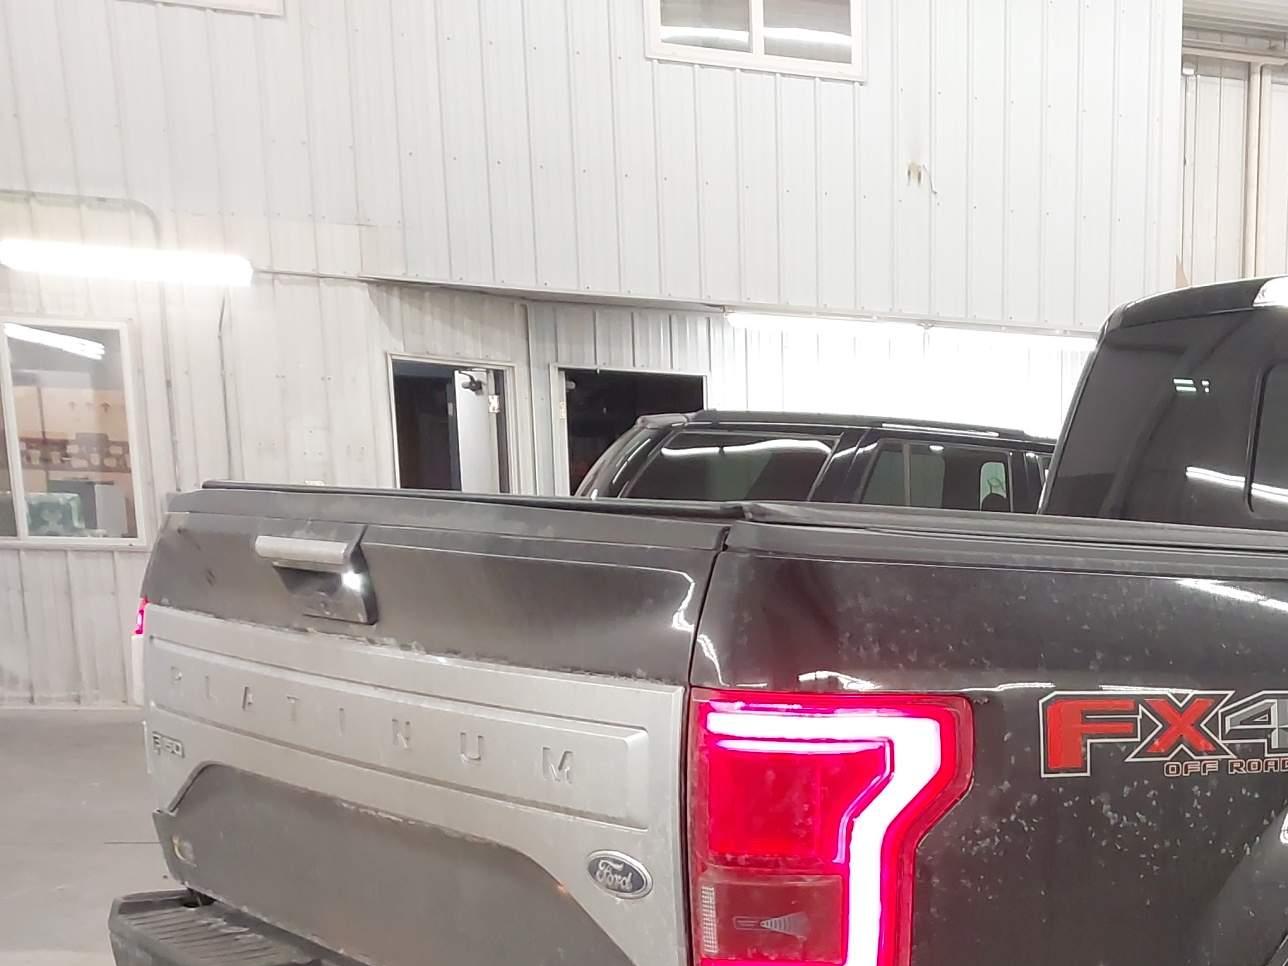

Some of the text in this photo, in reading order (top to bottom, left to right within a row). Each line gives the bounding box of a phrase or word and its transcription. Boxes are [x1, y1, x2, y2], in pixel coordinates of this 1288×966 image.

[170, 665, 573, 785] PLATINUM
[1164, 759, 1219, 776] OFF
[596, 859, 633, 890] Ford
